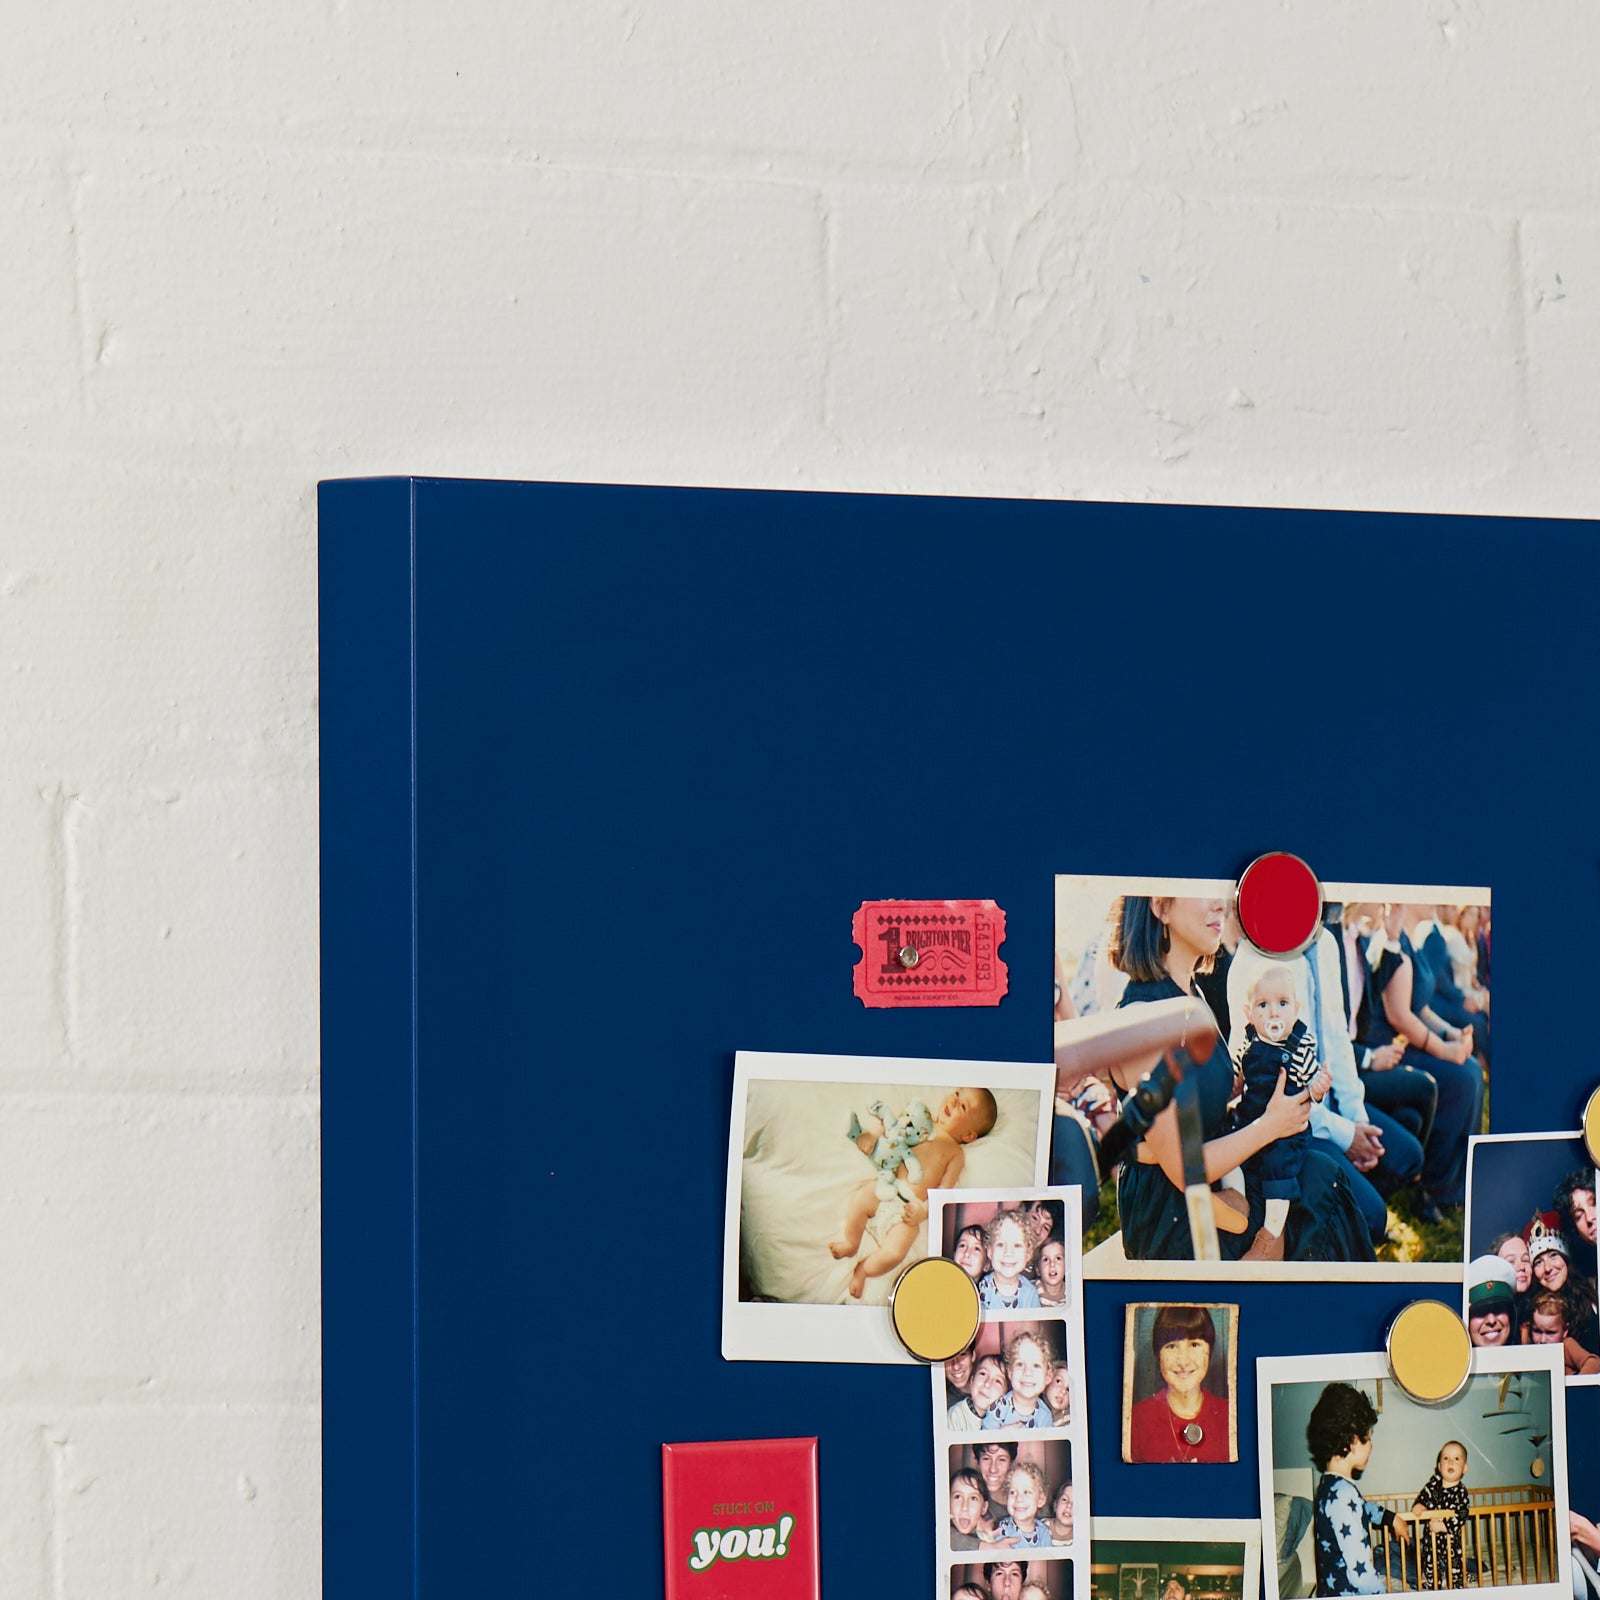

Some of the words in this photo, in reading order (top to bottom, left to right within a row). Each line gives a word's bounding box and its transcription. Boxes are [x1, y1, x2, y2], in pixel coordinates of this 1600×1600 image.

[906, 930, 949, 951] BRIGHTON
[951, 929, 972, 957] PIER
[712, 1502, 752, 1516] STUCK
[754, 1501, 775, 1513] ON
[689, 1514, 795, 1571] you!
